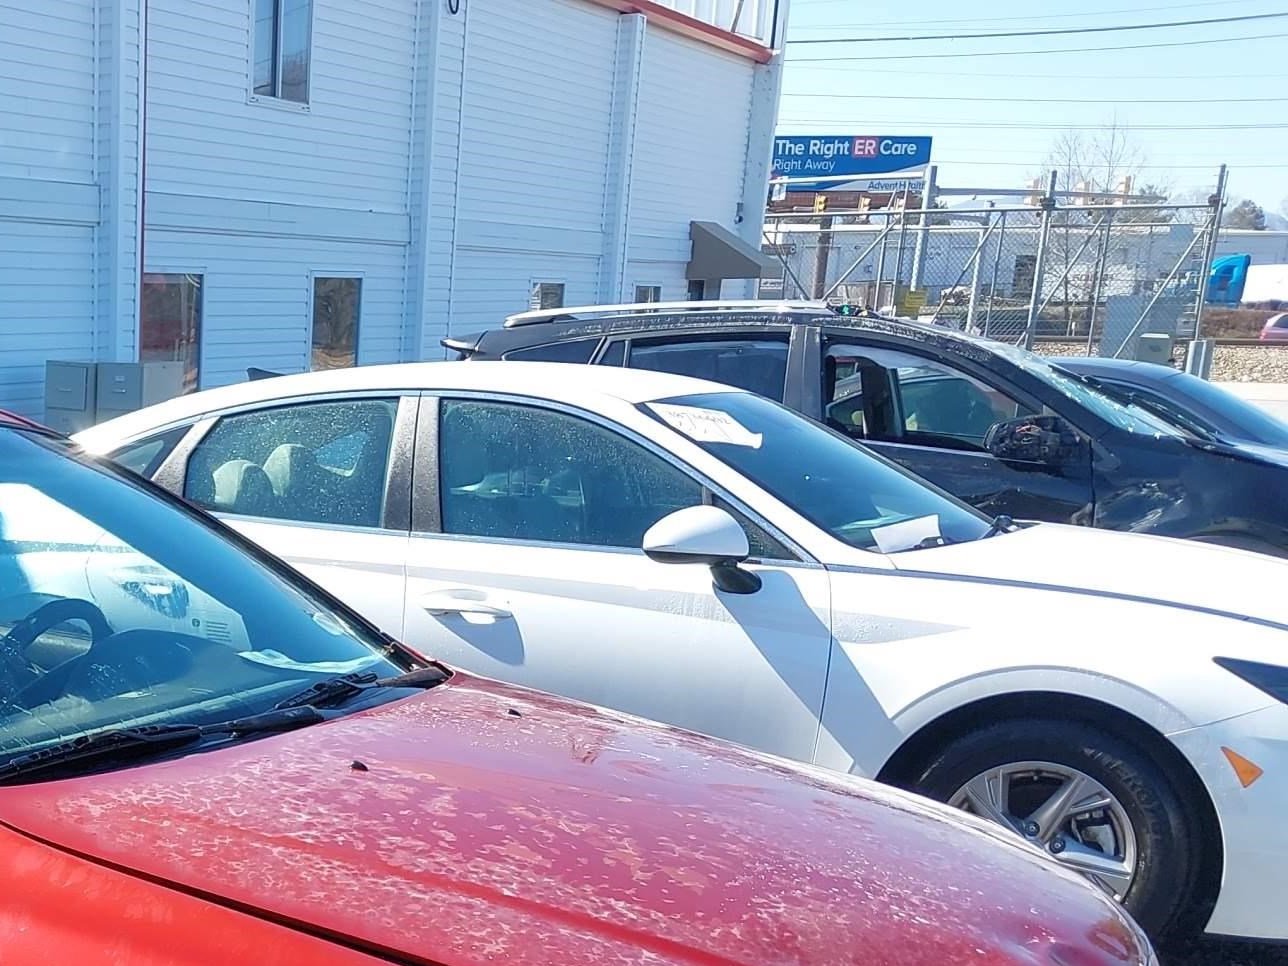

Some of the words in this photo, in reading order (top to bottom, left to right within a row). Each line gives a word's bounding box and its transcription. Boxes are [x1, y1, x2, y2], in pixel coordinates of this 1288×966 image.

[775, 139, 805, 155] The
[808, 139, 850, 158] Right
[854, 139, 876, 155] ER
[879, 139, 917, 155] Care
[773, 158, 802, 173] Right
[804, 158, 836, 173] Away
